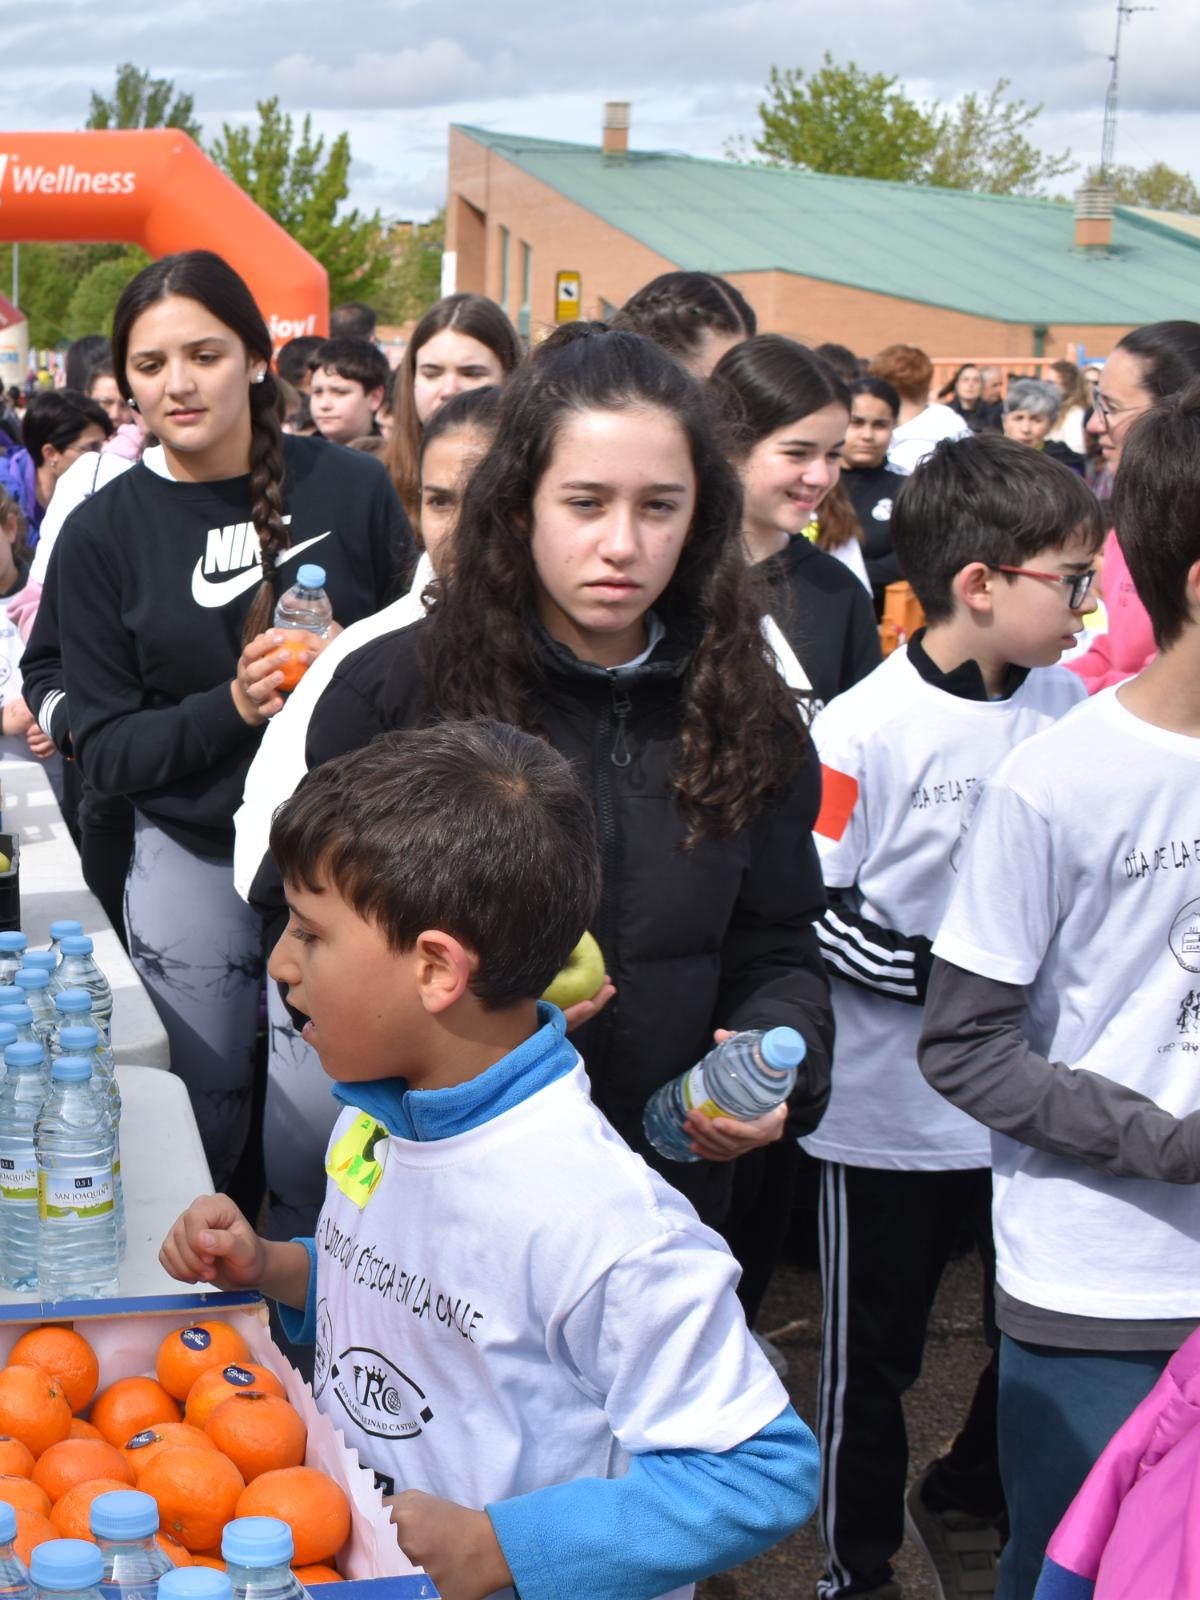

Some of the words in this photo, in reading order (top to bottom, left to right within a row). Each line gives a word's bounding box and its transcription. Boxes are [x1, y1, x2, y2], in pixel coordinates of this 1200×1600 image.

[12, 164, 136, 195] Wellness
[203, 514, 292, 575] NIK
[933, 784, 947, 804] DE
[948, 779, 966, 802] LA
[1125, 848, 1151, 878] DÍA
[1154, 847, 1168, 871] DE
[1172, 841, 1192, 868] LA
[54, 1192, 70, 1200] SAN
[72, 1188, 106, 1201] JOAQUIN
[353, 1245, 398, 1299] FÍSICA
[396, 1271, 417, 1305] EN
[412, 1277, 431, 1320] LA
[436, 1294, 484, 1344] CALLE
